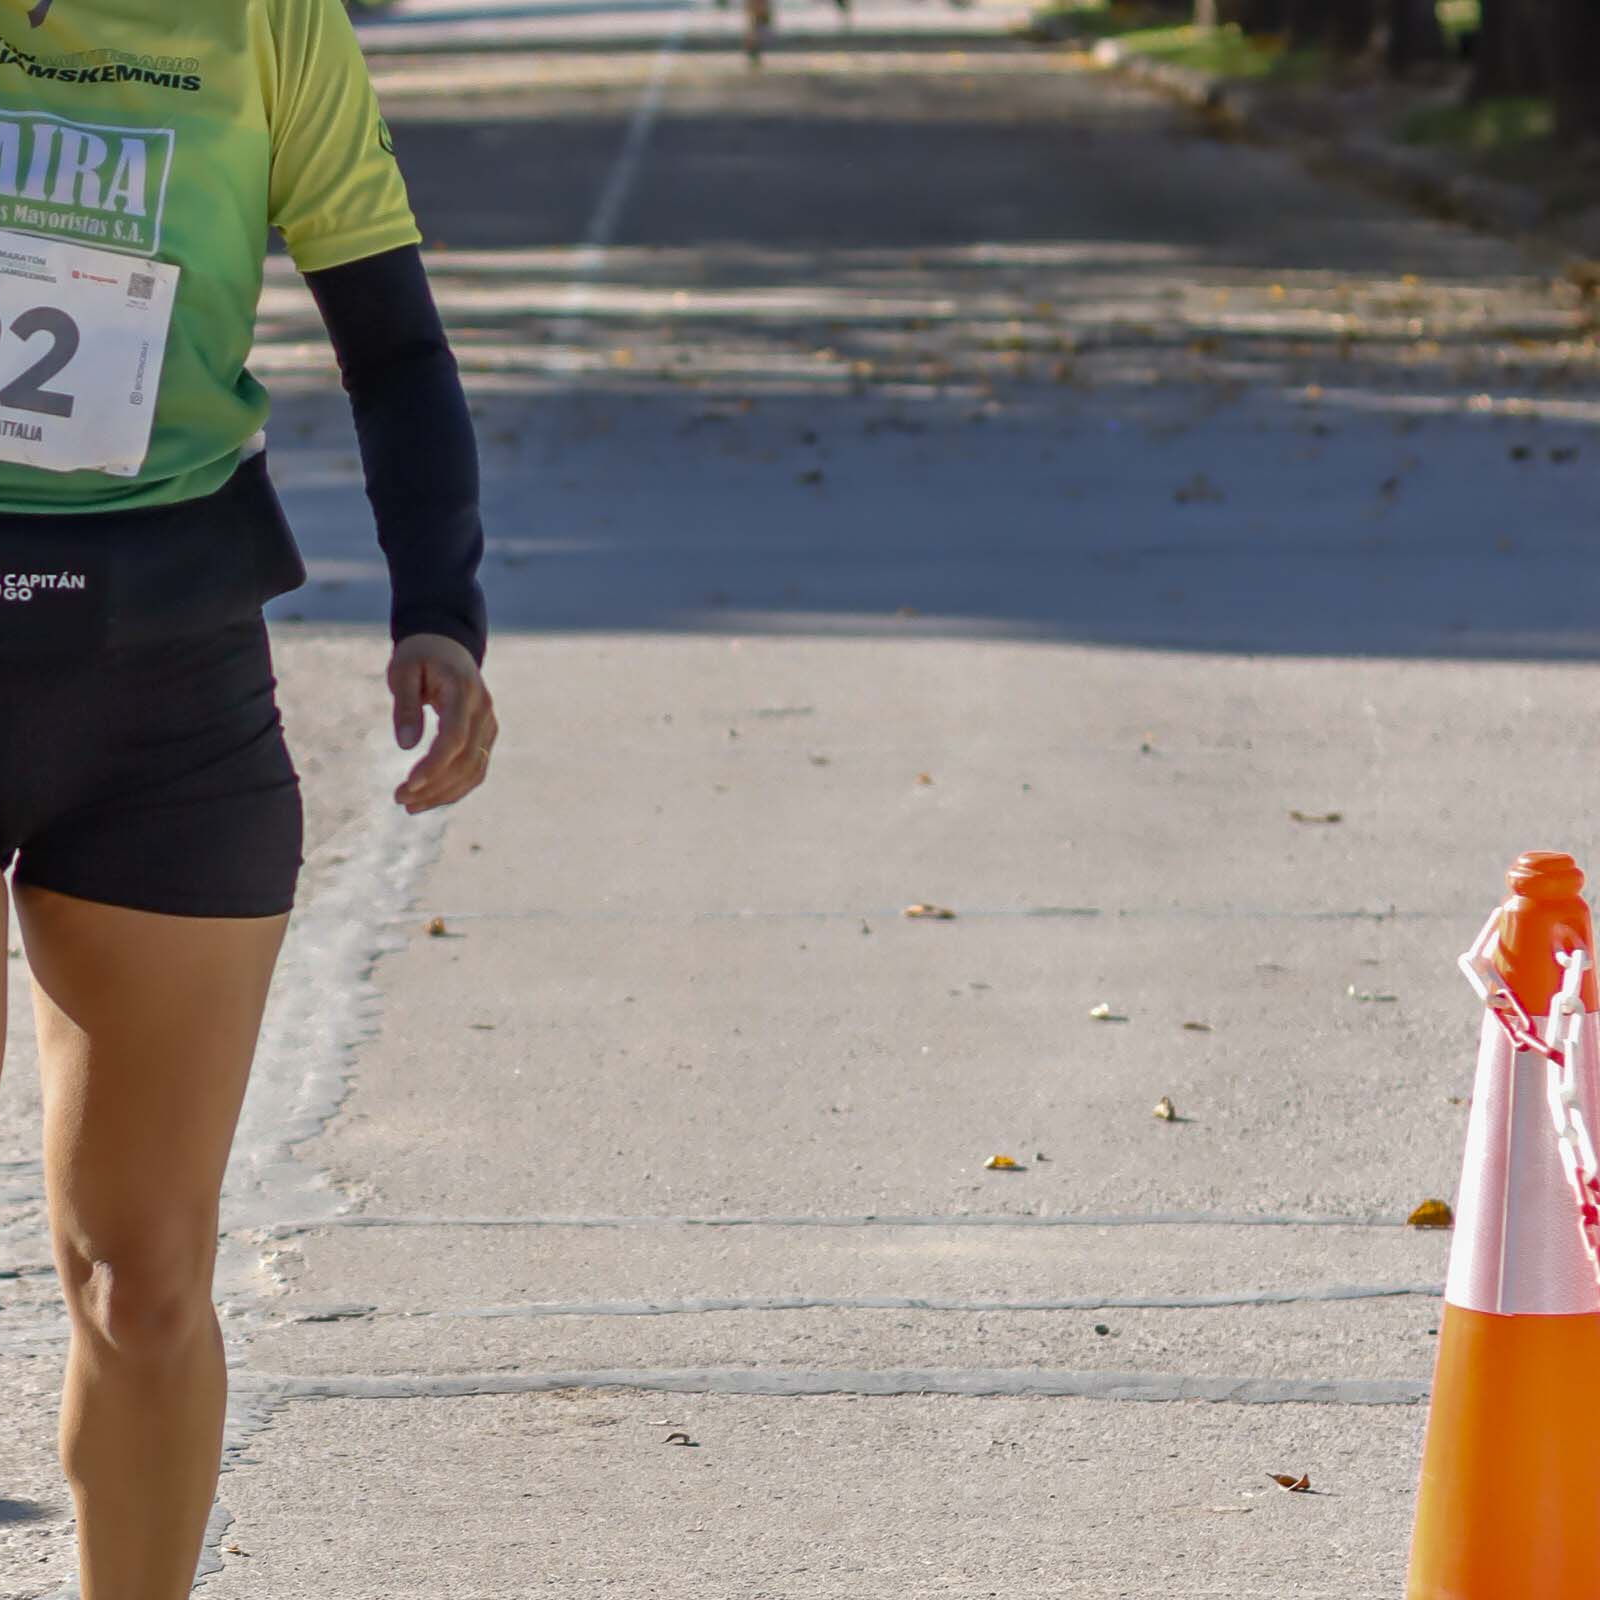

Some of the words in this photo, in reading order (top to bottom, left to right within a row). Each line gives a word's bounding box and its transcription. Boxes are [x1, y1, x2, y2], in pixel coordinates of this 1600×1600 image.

[13, 204, 106, 238] Mayoristas
[112, 217, 144, 244] S.A.
[3, 571, 85, 589] CAPITÁN
[3, 587, 33, 601] GO
